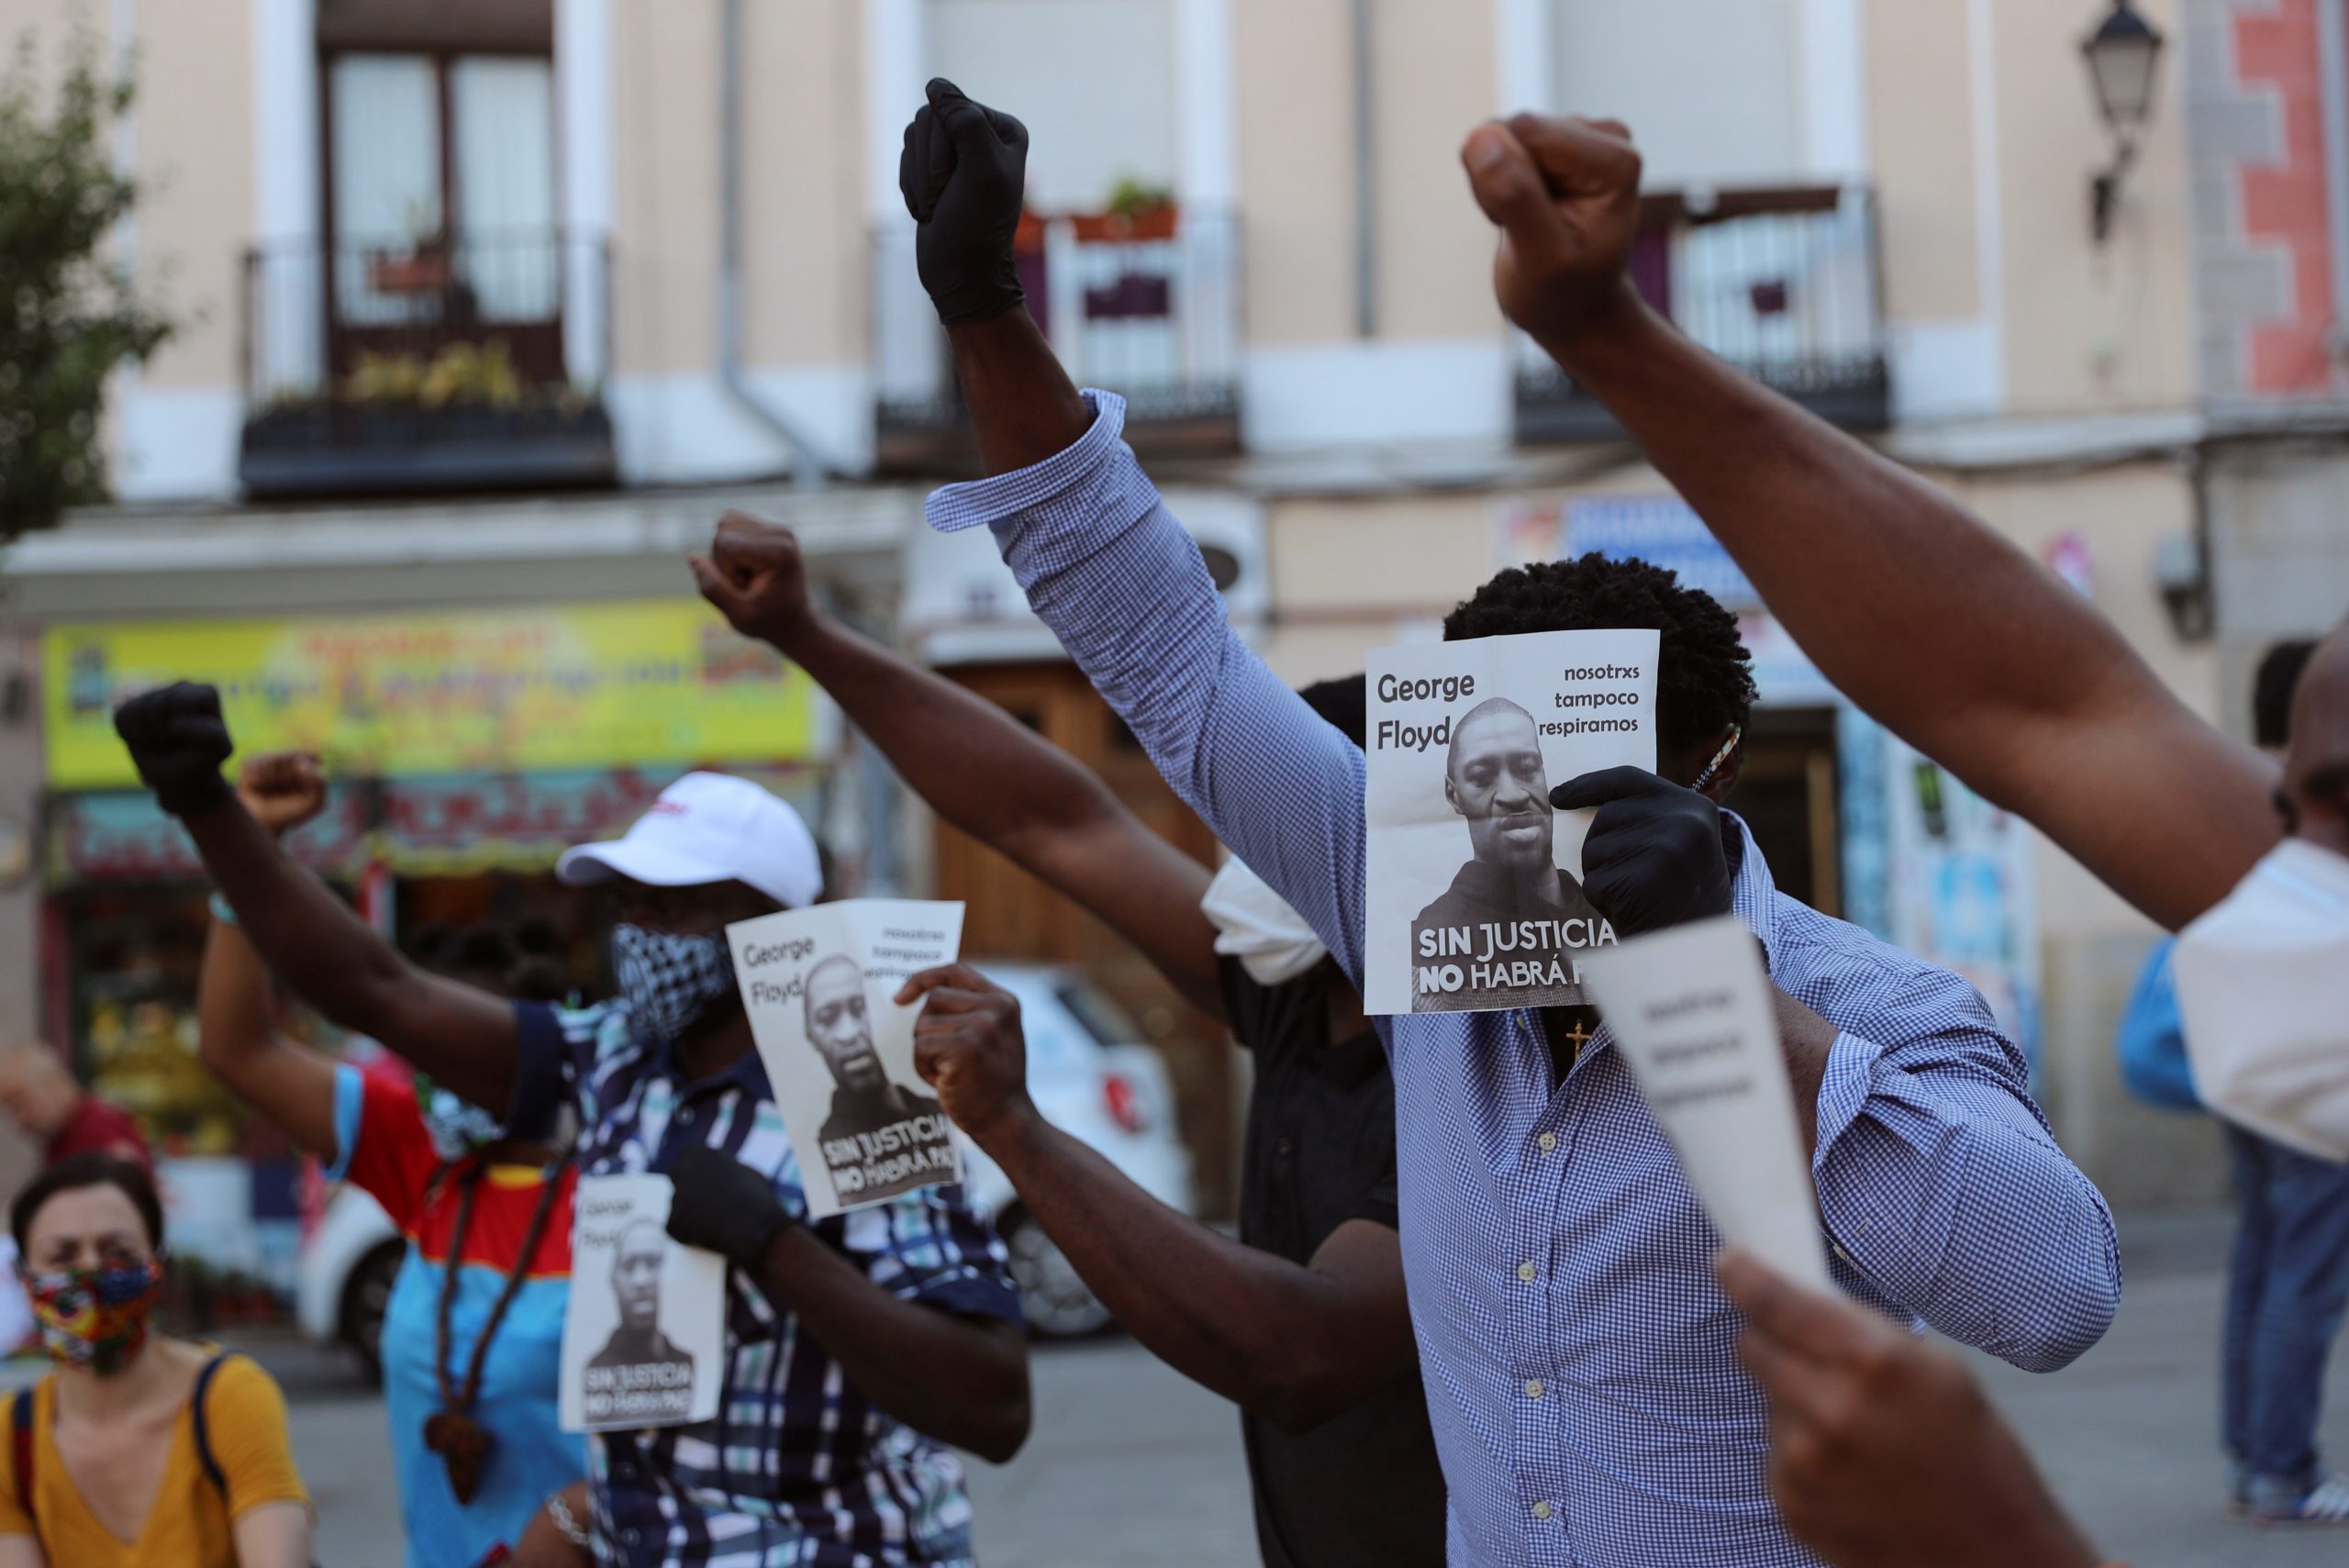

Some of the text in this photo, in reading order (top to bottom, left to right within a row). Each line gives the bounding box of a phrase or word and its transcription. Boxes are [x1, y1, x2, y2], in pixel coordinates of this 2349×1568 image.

[1564, 663, 1640, 681] nosotrxs
[1377, 673, 1475, 703] George
[1554, 693, 1639, 709] tampoco
[1377, 716, 1451, 752] Floyd
[1539, 717, 1638, 738] respiramos
[743, 937, 814, 967] George
[1419, 917, 1619, 962] SIN JUSTICIA
[1419, 964, 1464, 994] NO
[1470, 953, 1567, 989] HABRÁ
[751, 973, 804, 1006] Floyd
